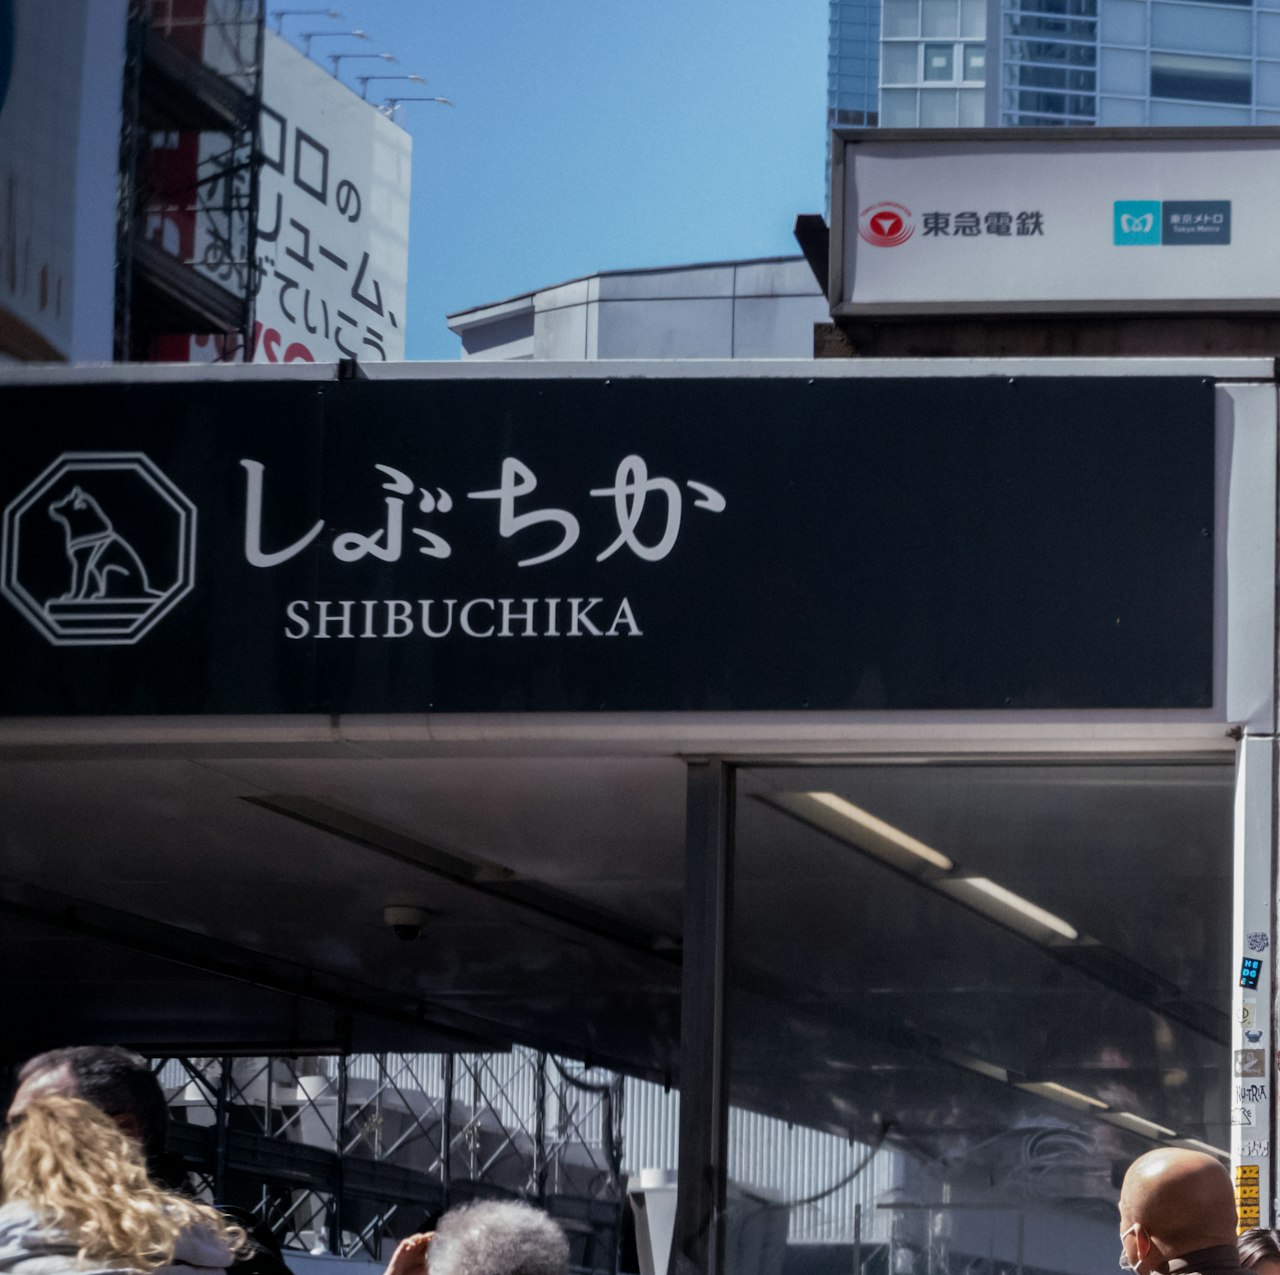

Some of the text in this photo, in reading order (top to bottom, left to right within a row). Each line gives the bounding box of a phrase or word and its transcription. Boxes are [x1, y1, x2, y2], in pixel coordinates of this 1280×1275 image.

[922, 211, 1045, 237] 東急電鉄
[1170, 213, 1224, 225] 東京メトロ
[239, 454, 727, 568] しぶちか
[284, 597, 643, 640] SHIBUCHIKA
